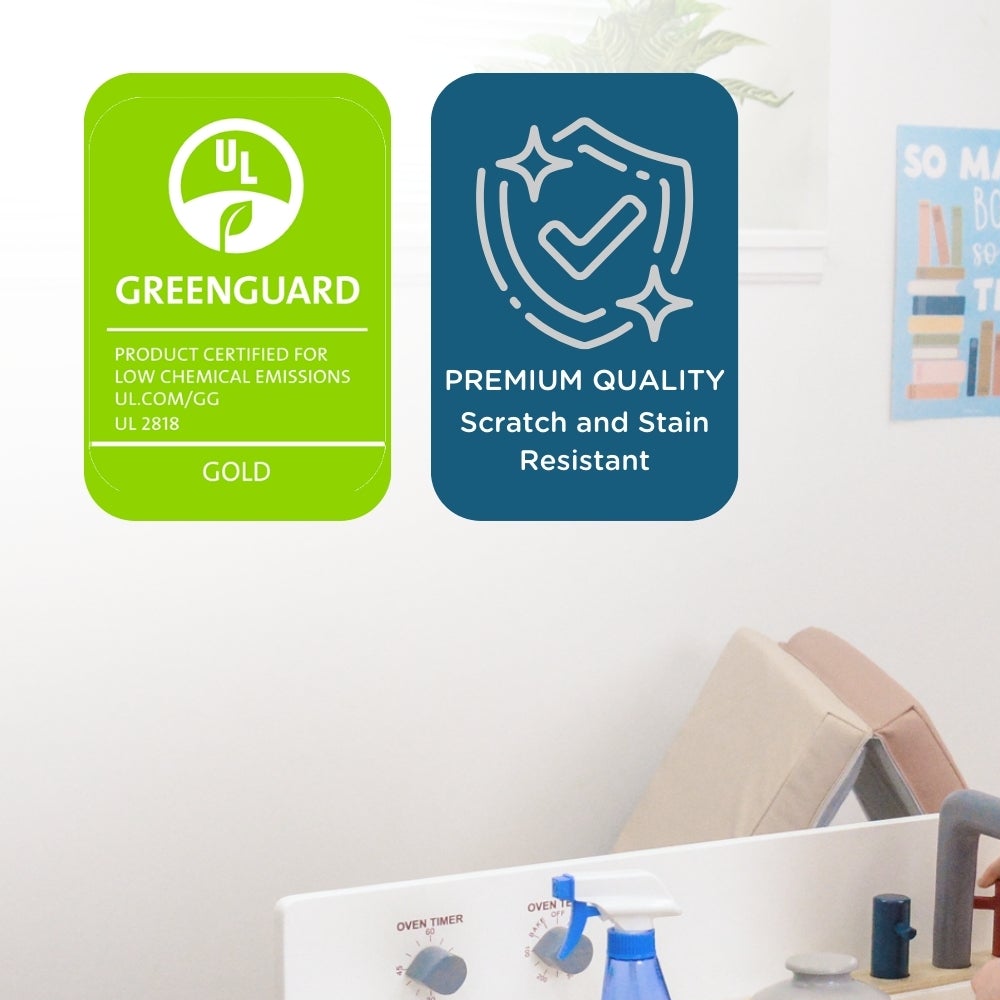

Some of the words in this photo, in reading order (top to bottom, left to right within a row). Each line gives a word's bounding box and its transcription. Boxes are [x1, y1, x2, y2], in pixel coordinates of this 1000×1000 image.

[903, 144, 947, 179] SO
[972, 241, 999, 265] so
[528, 900, 557, 912] OVEN
[396, 919, 427, 932] OVEN
[430, 914, 464, 927] TIMER
